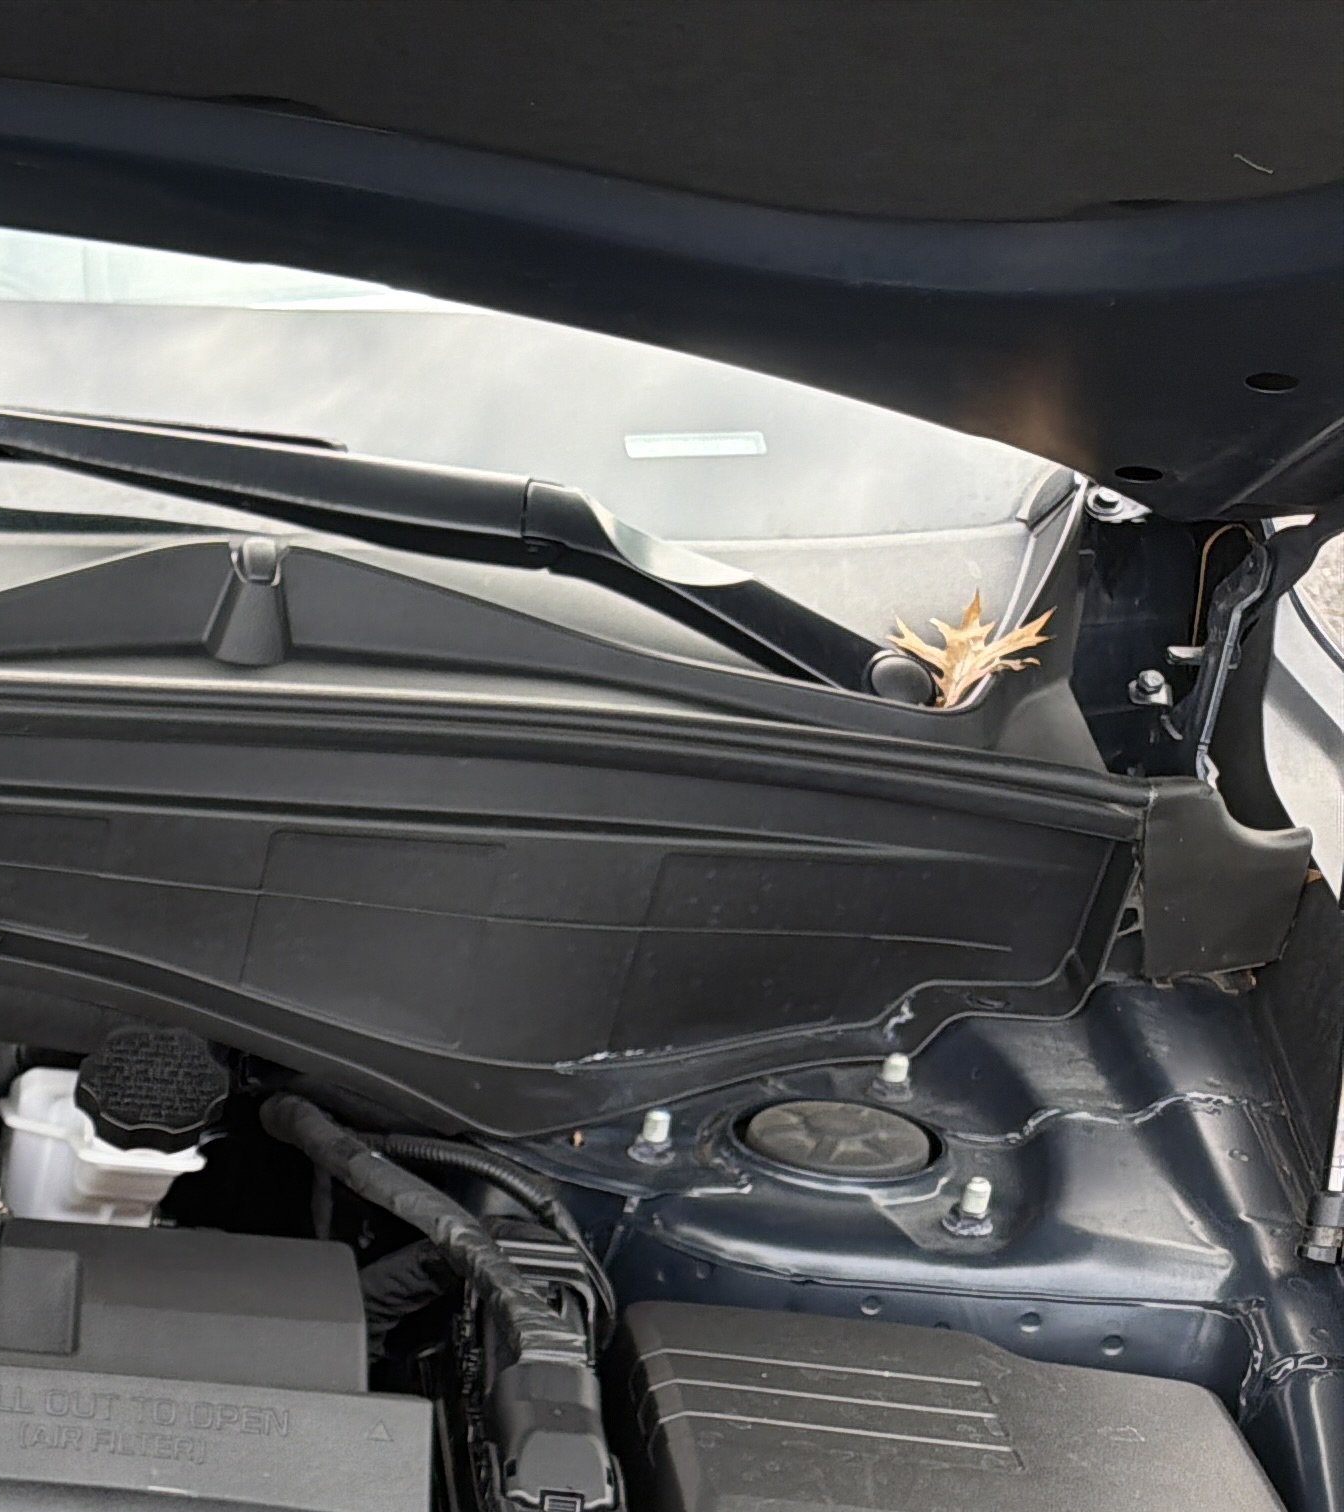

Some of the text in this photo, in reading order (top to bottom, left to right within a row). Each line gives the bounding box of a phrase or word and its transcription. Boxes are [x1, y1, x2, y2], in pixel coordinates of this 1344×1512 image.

[44, 1388, 119, 1421] OUT
[130, 1395, 178, 1426] TO
[187, 1400, 290, 1438] OPEN
[18, 1421, 208, 1464] (AIR FILTER)
